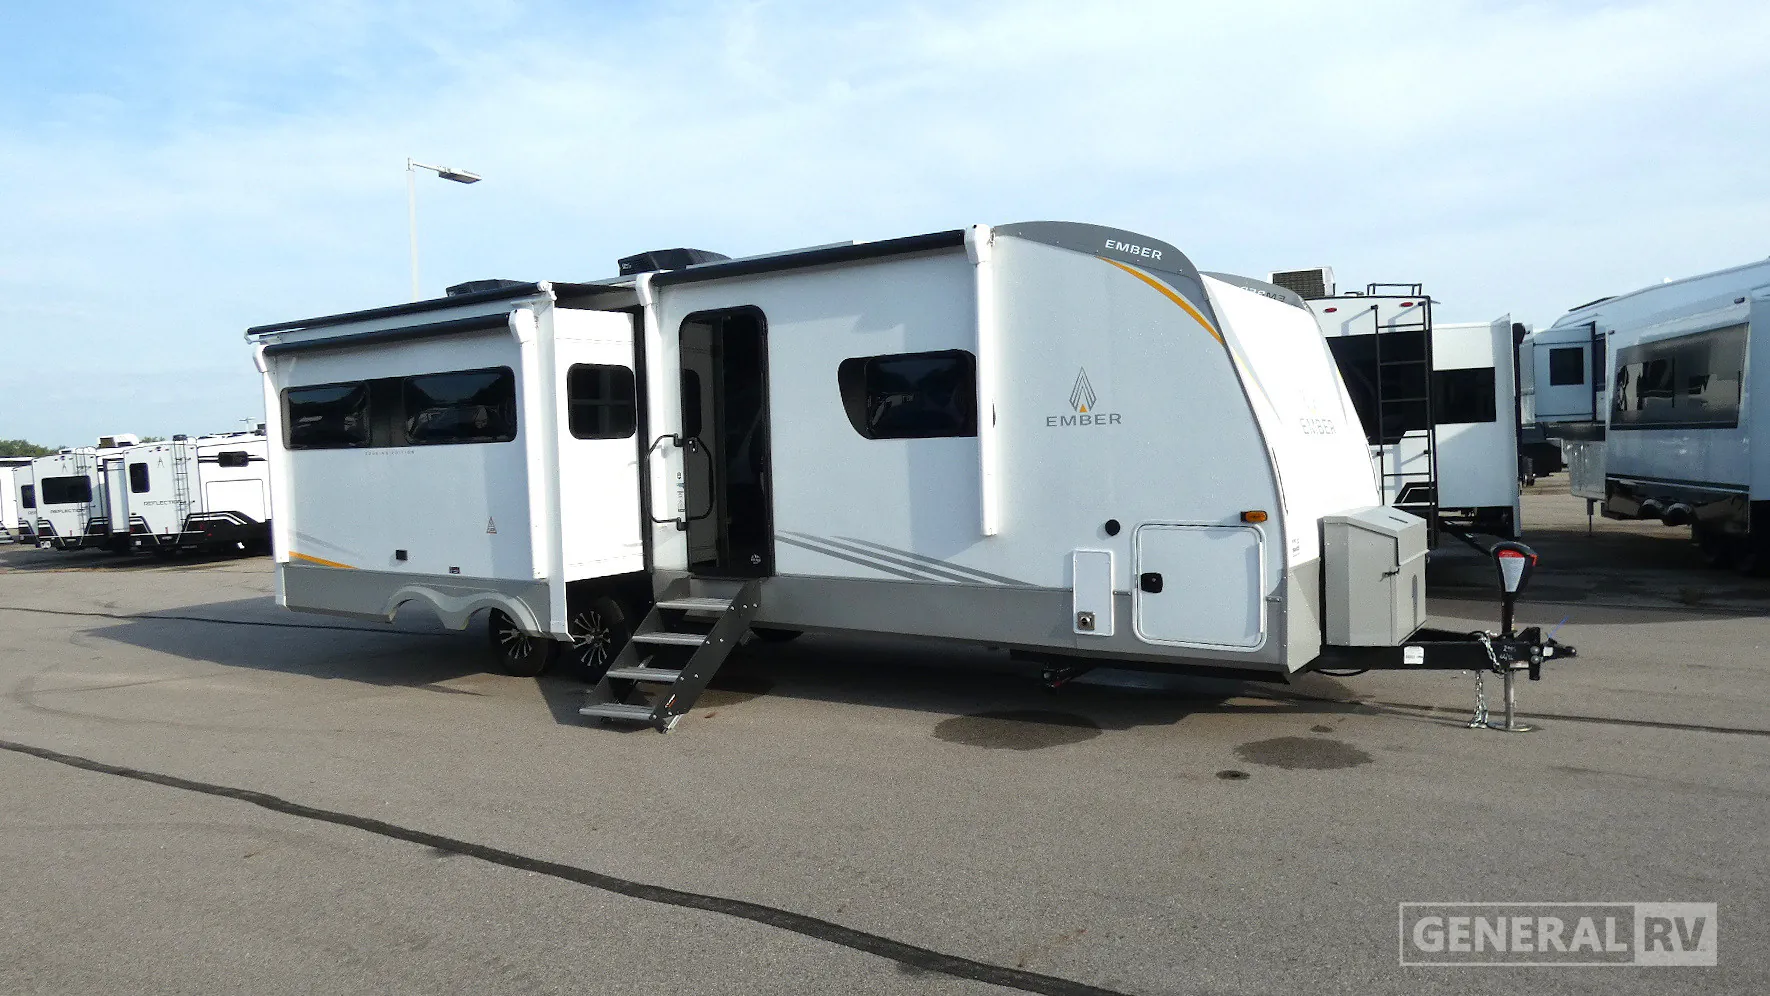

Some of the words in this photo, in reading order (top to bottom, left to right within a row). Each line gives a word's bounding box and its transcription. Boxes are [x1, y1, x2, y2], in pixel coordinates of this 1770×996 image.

[1105, 239, 1163, 261] EMBER
[1046, 413, 1122, 427] EMBER
[1300, 418, 1337, 435] EMBER
